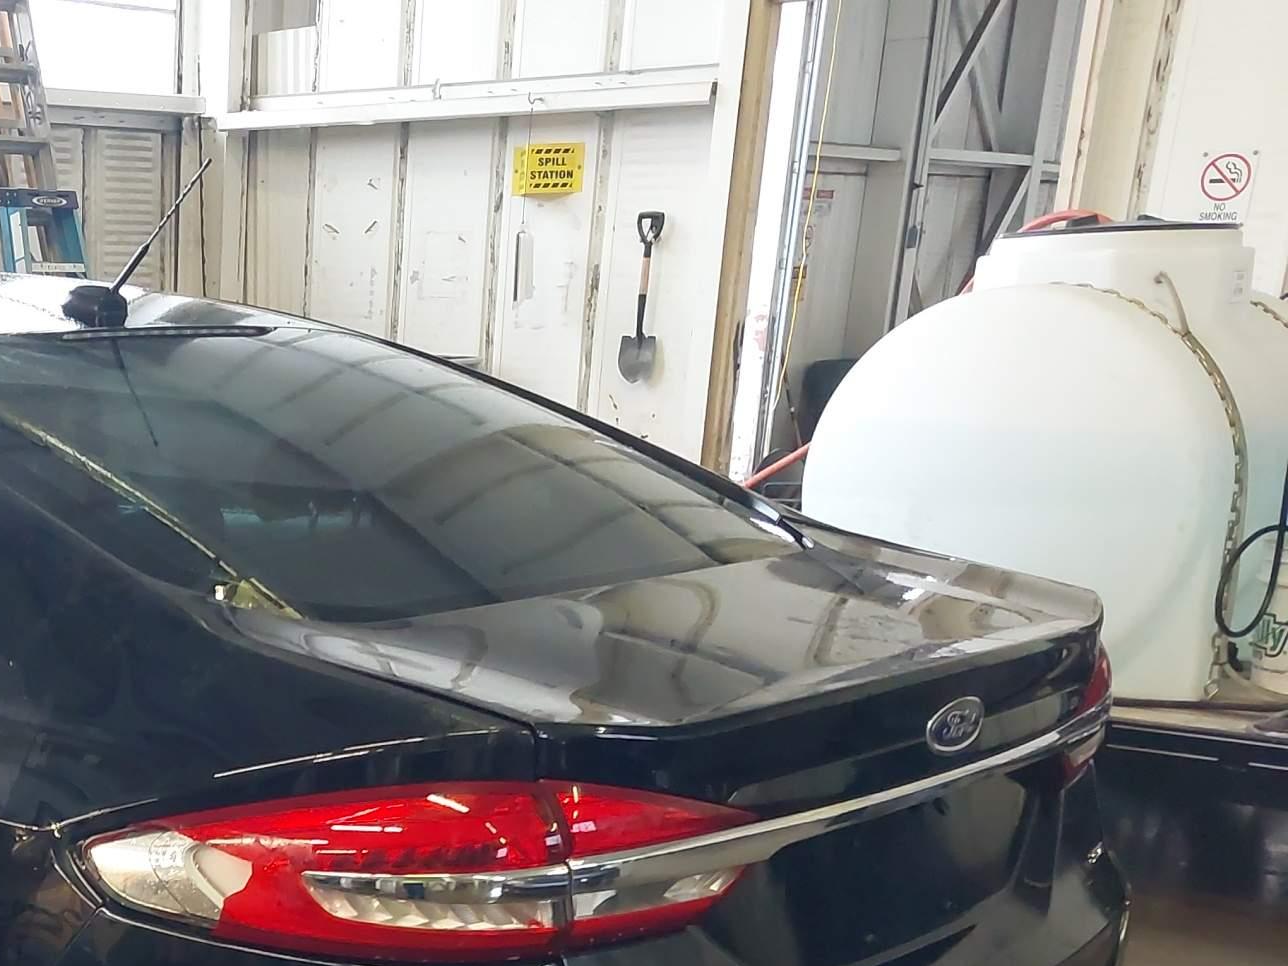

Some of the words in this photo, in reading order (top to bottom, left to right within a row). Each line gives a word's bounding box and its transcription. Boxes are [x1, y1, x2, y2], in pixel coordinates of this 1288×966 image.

[538, 157, 567, 166] SPILL
[529, 170, 574, 180] STATION
[1213, 203, 1226, 211] NO
[1199, 212, 1238, 221] SMOKING
